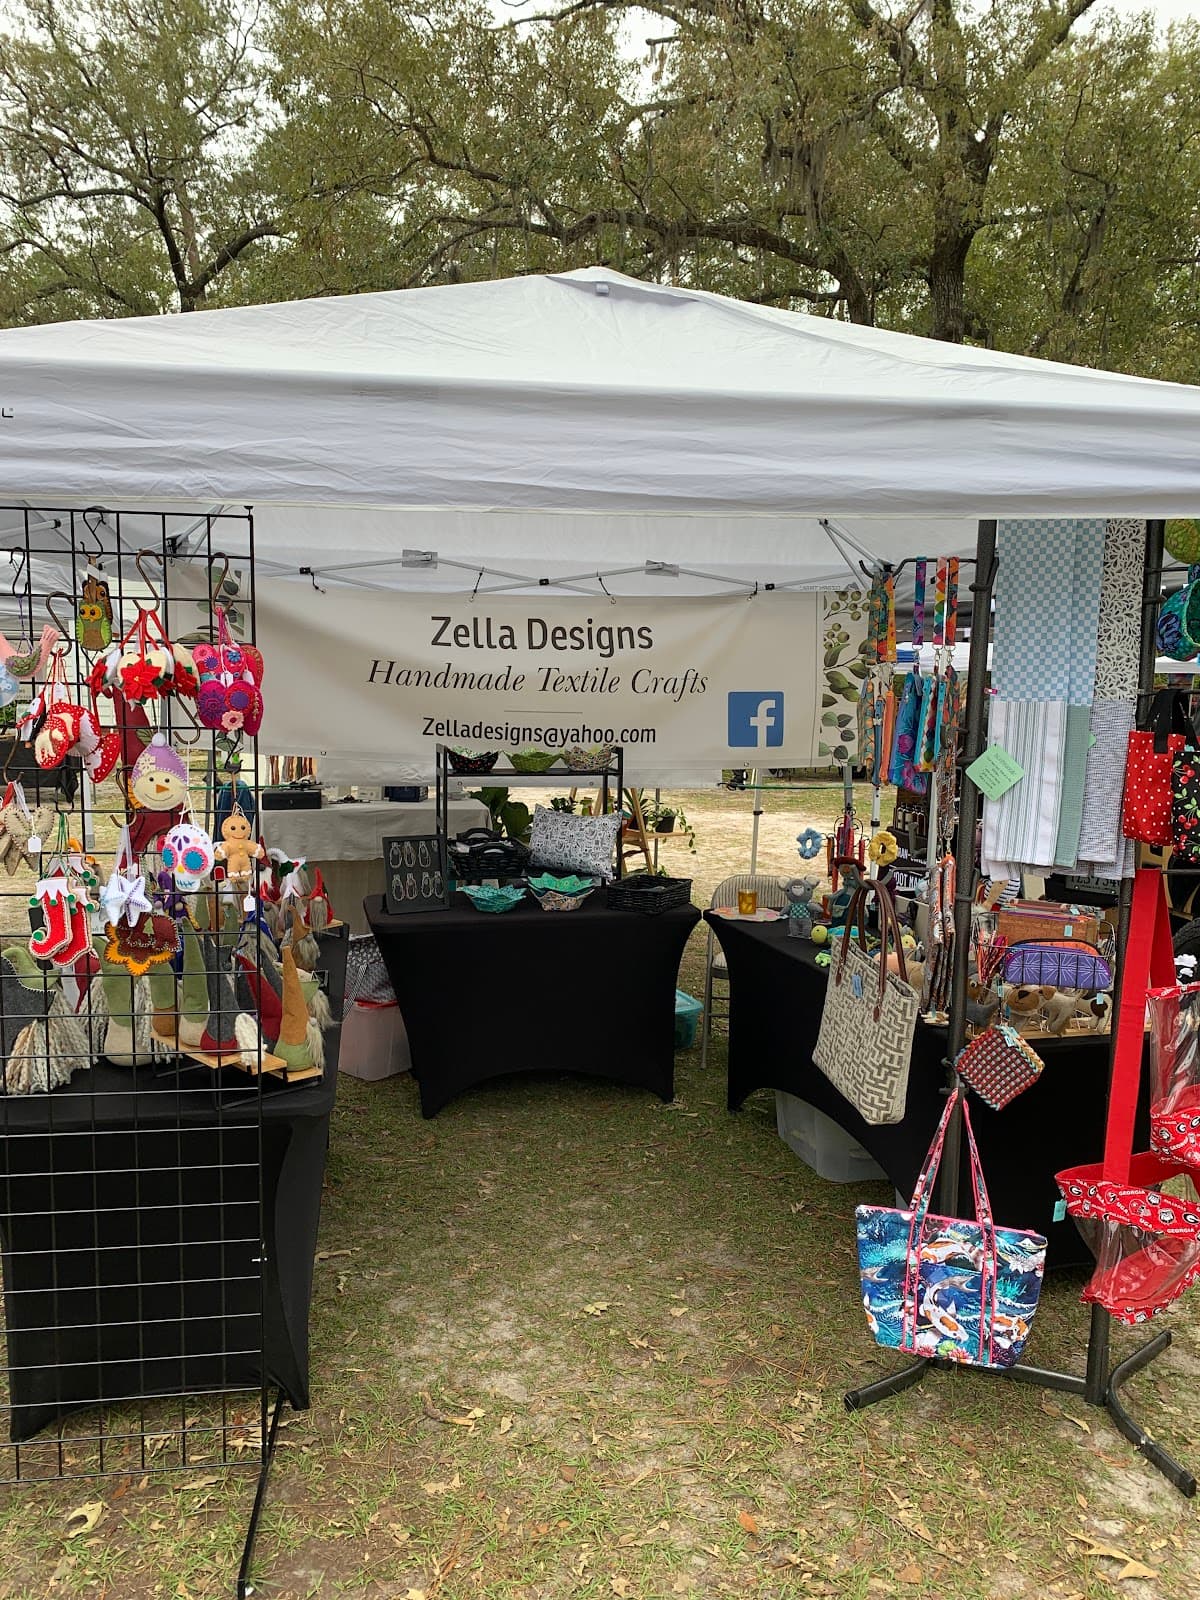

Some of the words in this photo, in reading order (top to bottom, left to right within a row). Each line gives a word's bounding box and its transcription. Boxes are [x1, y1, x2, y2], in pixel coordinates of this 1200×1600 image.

[431, 616, 517, 649] Zella
[527, 618, 653, 658] Designs
[367, 659, 526, 691] Handmade
[537, 667, 620, 694] Textile
[631, 668, 709, 703] Crafts
[422, 717, 656, 748] Zelladesigns@yahoo.com
